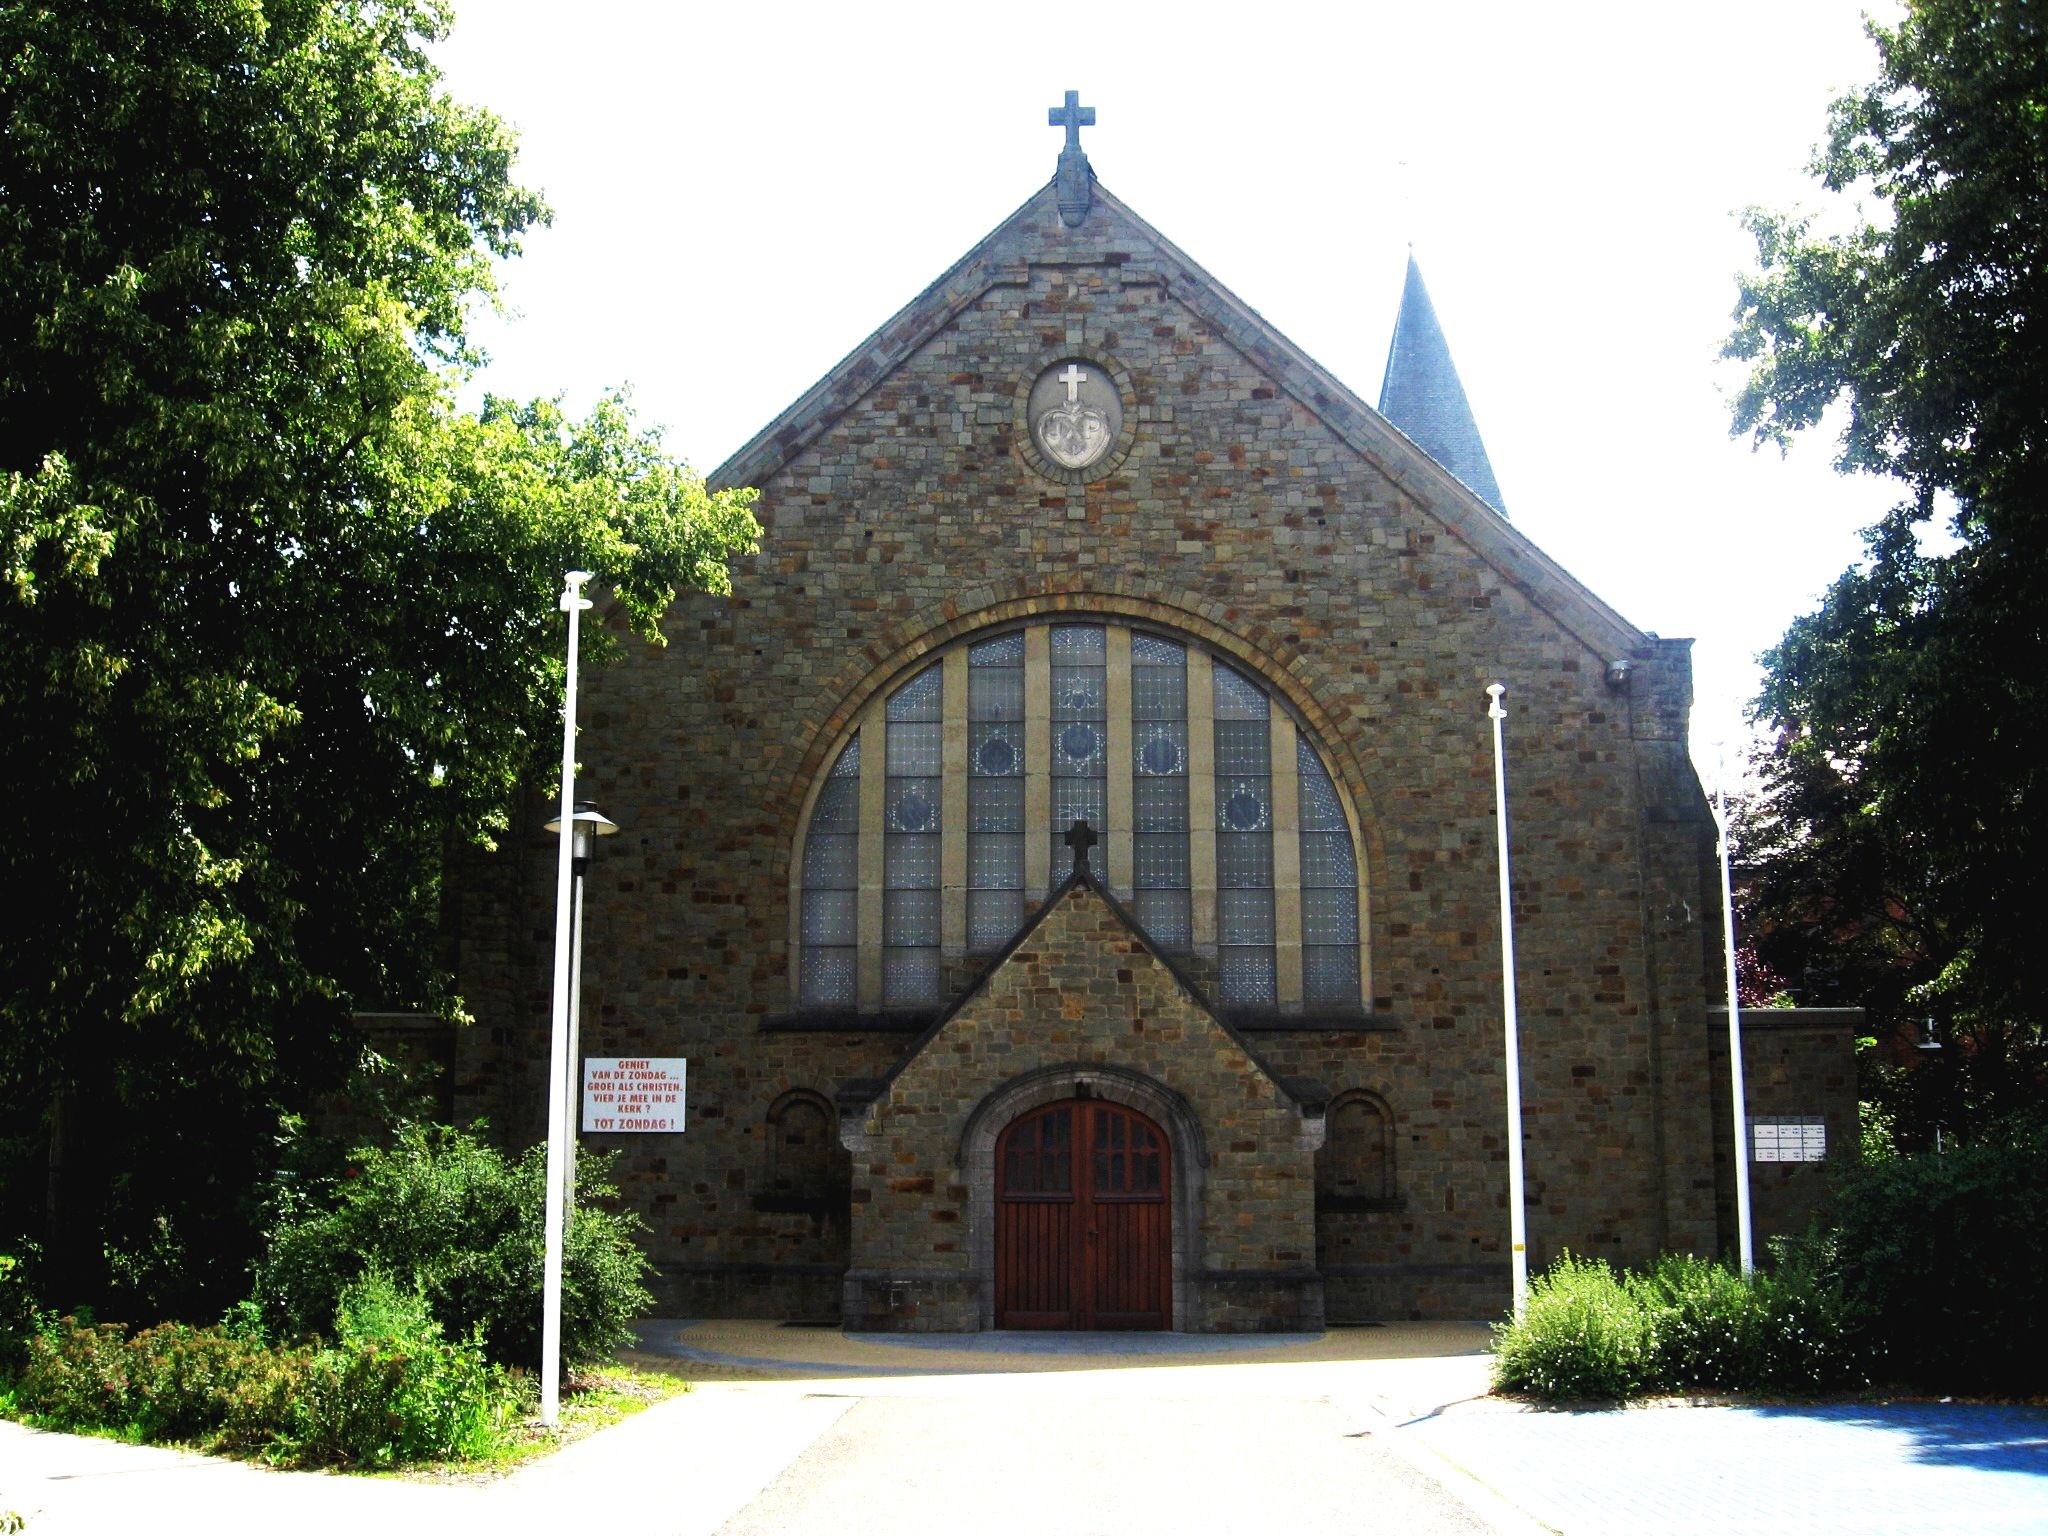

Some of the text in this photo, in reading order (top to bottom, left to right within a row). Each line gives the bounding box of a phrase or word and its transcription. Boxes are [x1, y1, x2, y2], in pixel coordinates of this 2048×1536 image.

[619, 1061, 650, 1070] GENIET
[592, 1071, 610, 1080] VAN
[614, 1071, 625, 1080] DE
[628, 1071, 666, 1080] ZONDAG
[587, 1082, 683, 1092] GROEI ALS CHRISTEN.
[593, 1094, 677, 1103] VIER JE MEE IN DE
[618, 1105, 651, 1113] KERK ?
[594, 1119, 615, 1130] TOT
[619, 1119, 666, 1130] ZONDAG
